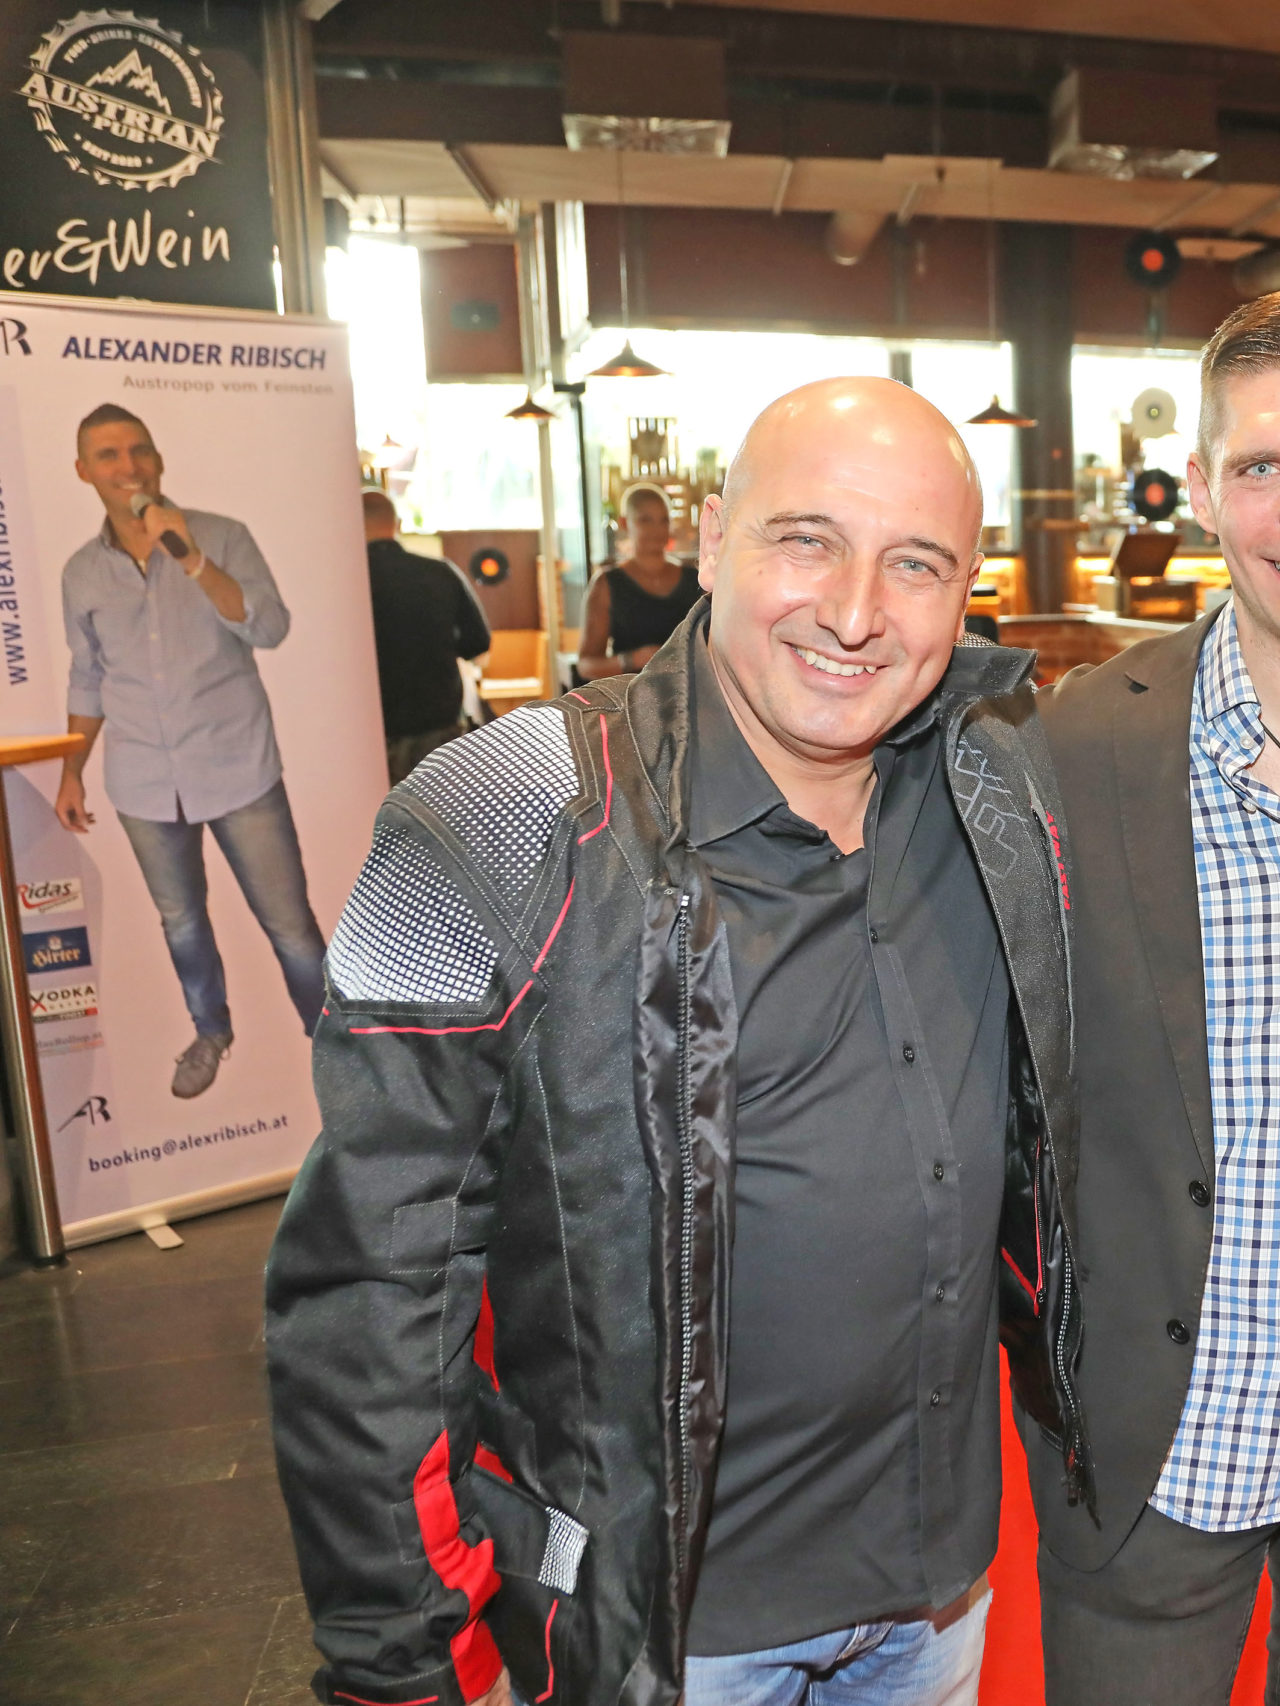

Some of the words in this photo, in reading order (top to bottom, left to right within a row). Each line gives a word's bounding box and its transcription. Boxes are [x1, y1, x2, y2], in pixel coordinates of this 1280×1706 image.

[20, 72, 219, 158] AUSTRIAN
[93, 115, 146, 144] PUB
[62, 336, 222, 366] ALEXANDER
[230, 344, 327, 370] RIBISCH
[123, 375, 215, 394] Austropop
[222, 378, 258, 392] vom
[264, 379, 334, 395] Feinsten
[88, 1114, 289, 1173] booking@alexribisch.at
